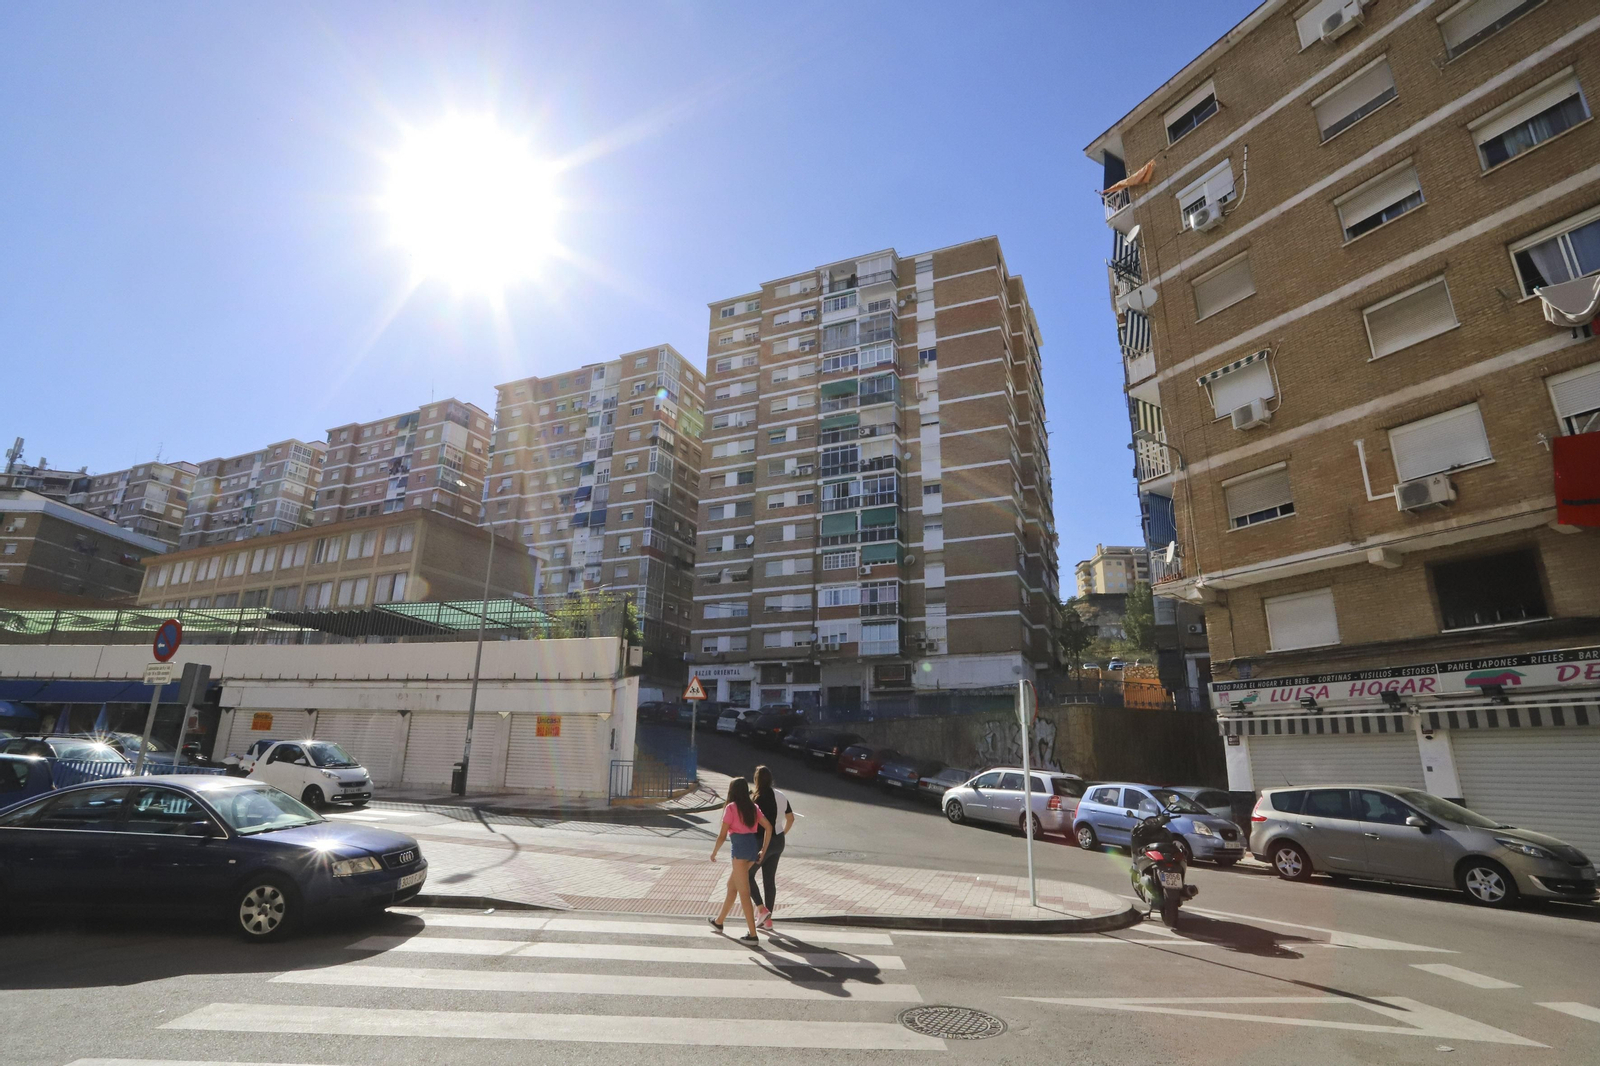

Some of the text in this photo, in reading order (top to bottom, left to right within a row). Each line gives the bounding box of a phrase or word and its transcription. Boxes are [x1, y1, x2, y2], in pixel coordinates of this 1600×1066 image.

[1216, 684, 1231, 692] TODO
[1257, 680, 1278, 688] HOGAR
[1285, 678, 1292, 686] EL
[1294, 677, 1310, 685] BEBE
[1318, 673, 1352, 683] CORTINAS
[1360, 669, 1392, 680] VISILLOS
[1401, 666, 1435, 676] ESTORES
[1447, 662, 1474, 671] PANEL
[1476, 657, 1518, 669] JAPONES
[1530, 653, 1564, 665] RIELES
[1270, 677, 1436, 702] LUISA HOGAR
